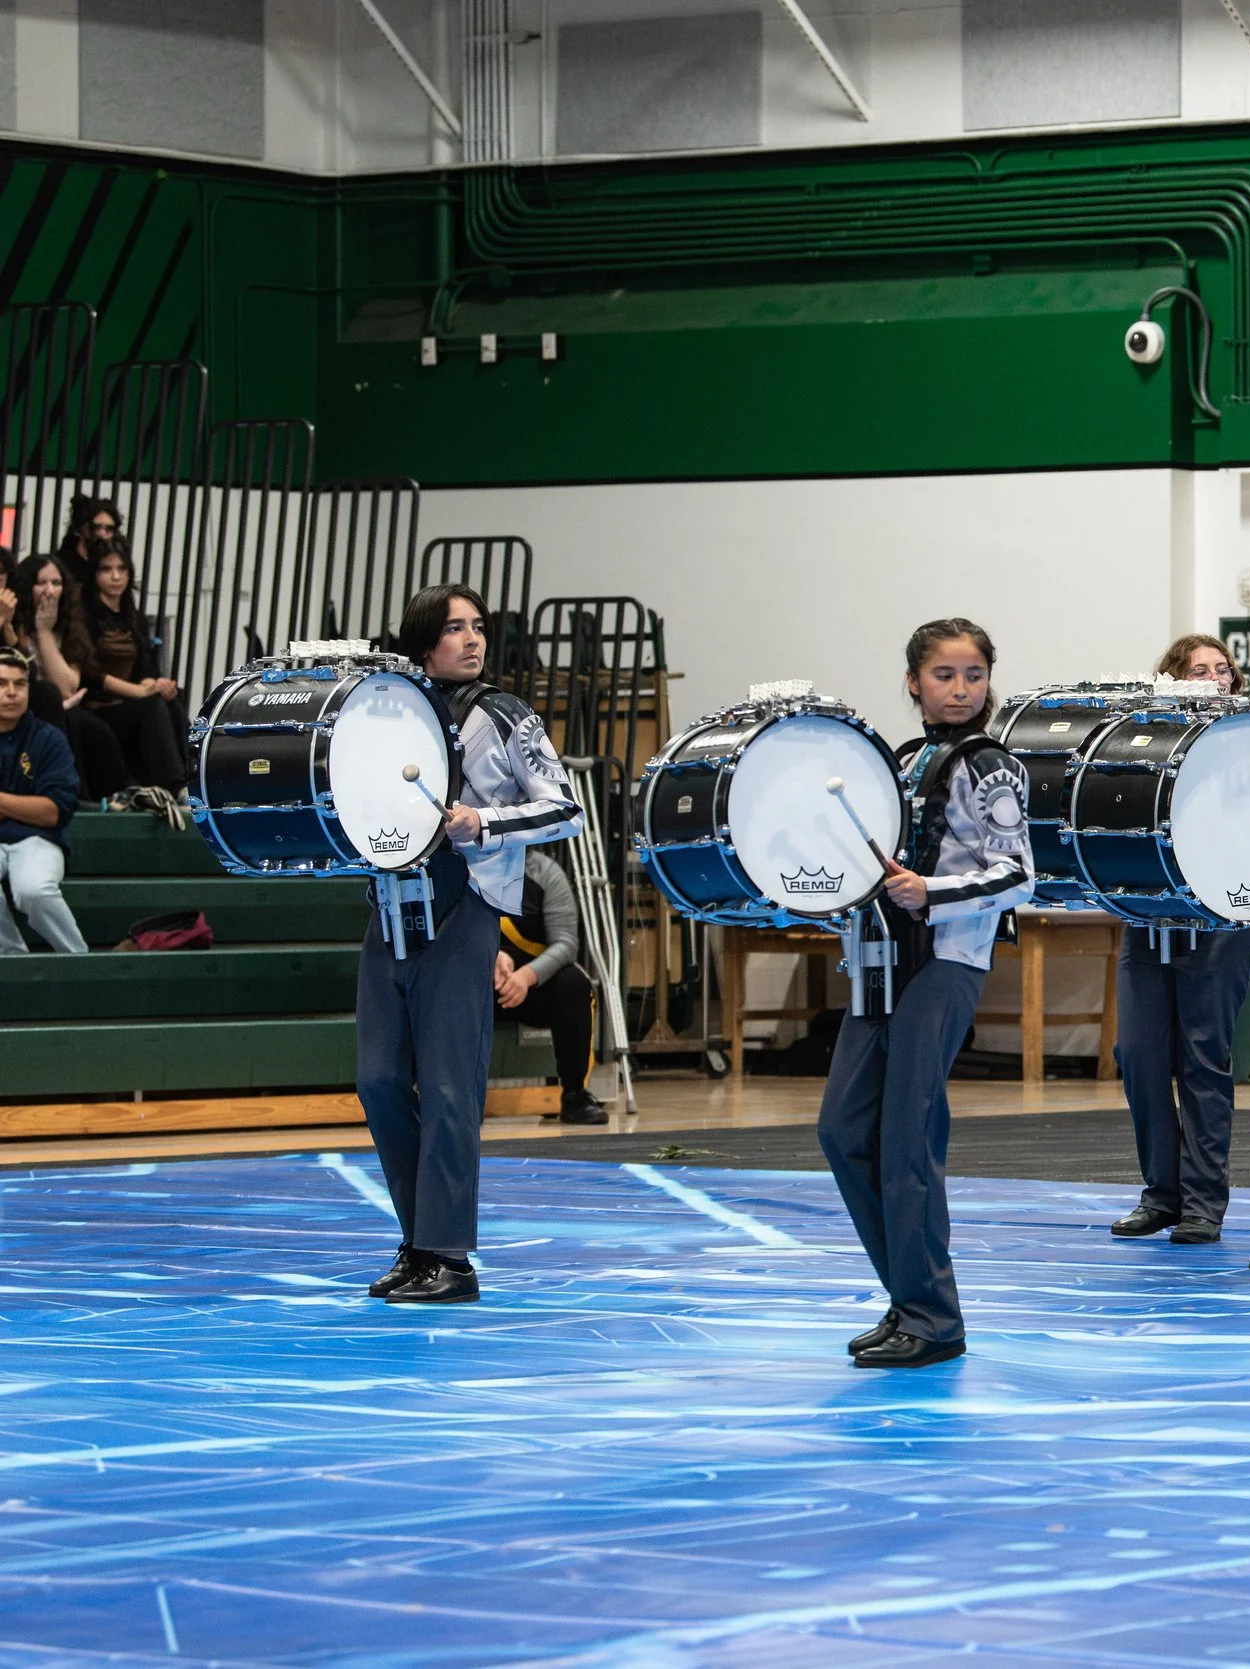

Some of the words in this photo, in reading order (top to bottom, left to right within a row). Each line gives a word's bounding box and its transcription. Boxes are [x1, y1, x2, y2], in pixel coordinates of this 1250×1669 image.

[263, 692, 313, 706] YAMAHA
[374, 840, 405, 851] REMO
[790, 881, 836, 890] REMO
